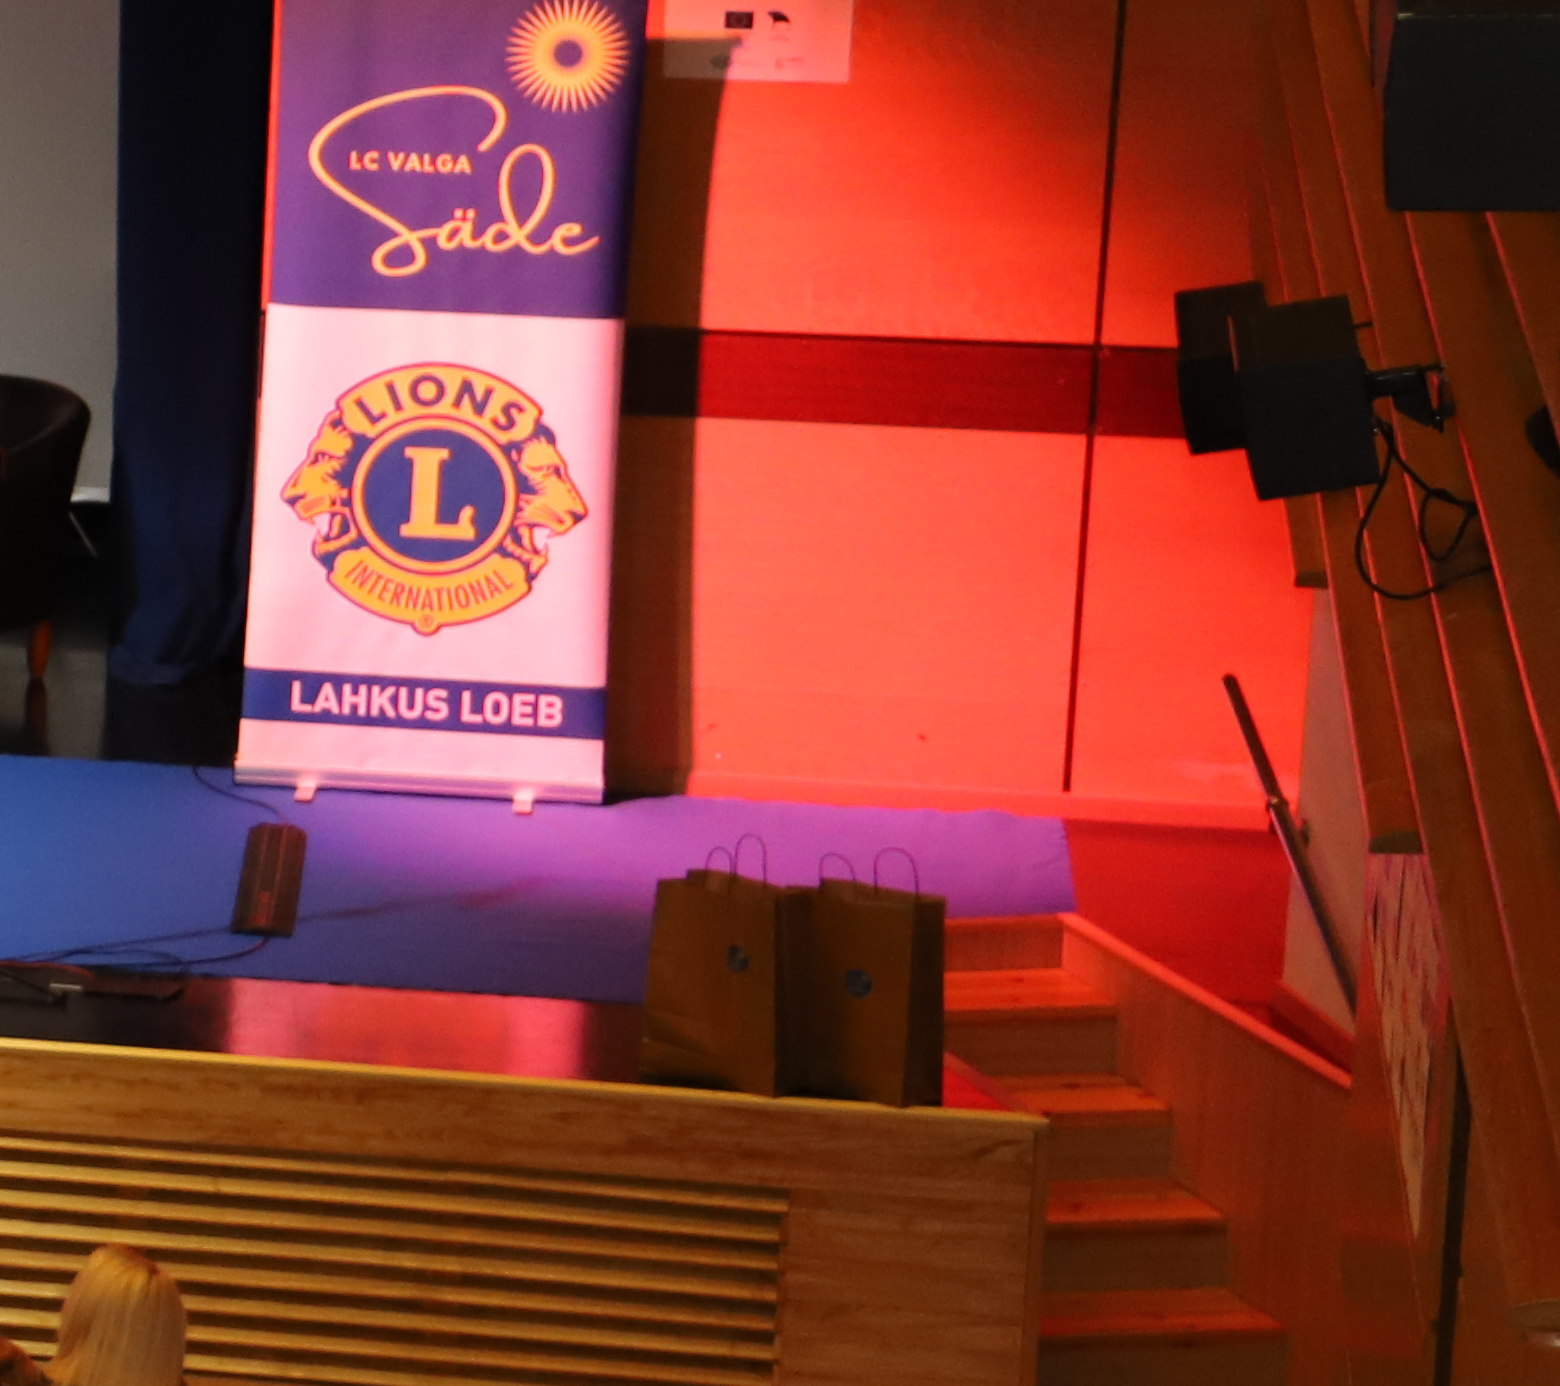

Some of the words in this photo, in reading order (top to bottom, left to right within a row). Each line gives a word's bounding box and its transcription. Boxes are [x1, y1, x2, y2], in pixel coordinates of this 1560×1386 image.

[307, 84, 601, 278] Säde
[349, 149, 380, 171] LC
[386, 150, 472, 174] VALGA
[352, 373, 526, 432] LIONS
[398, 445, 478, 541] L
[342, 558, 515, 614] INTERNATIONAL
[289, 678, 451, 723] LAHKUS
[458, 689, 565, 729] LOEB
